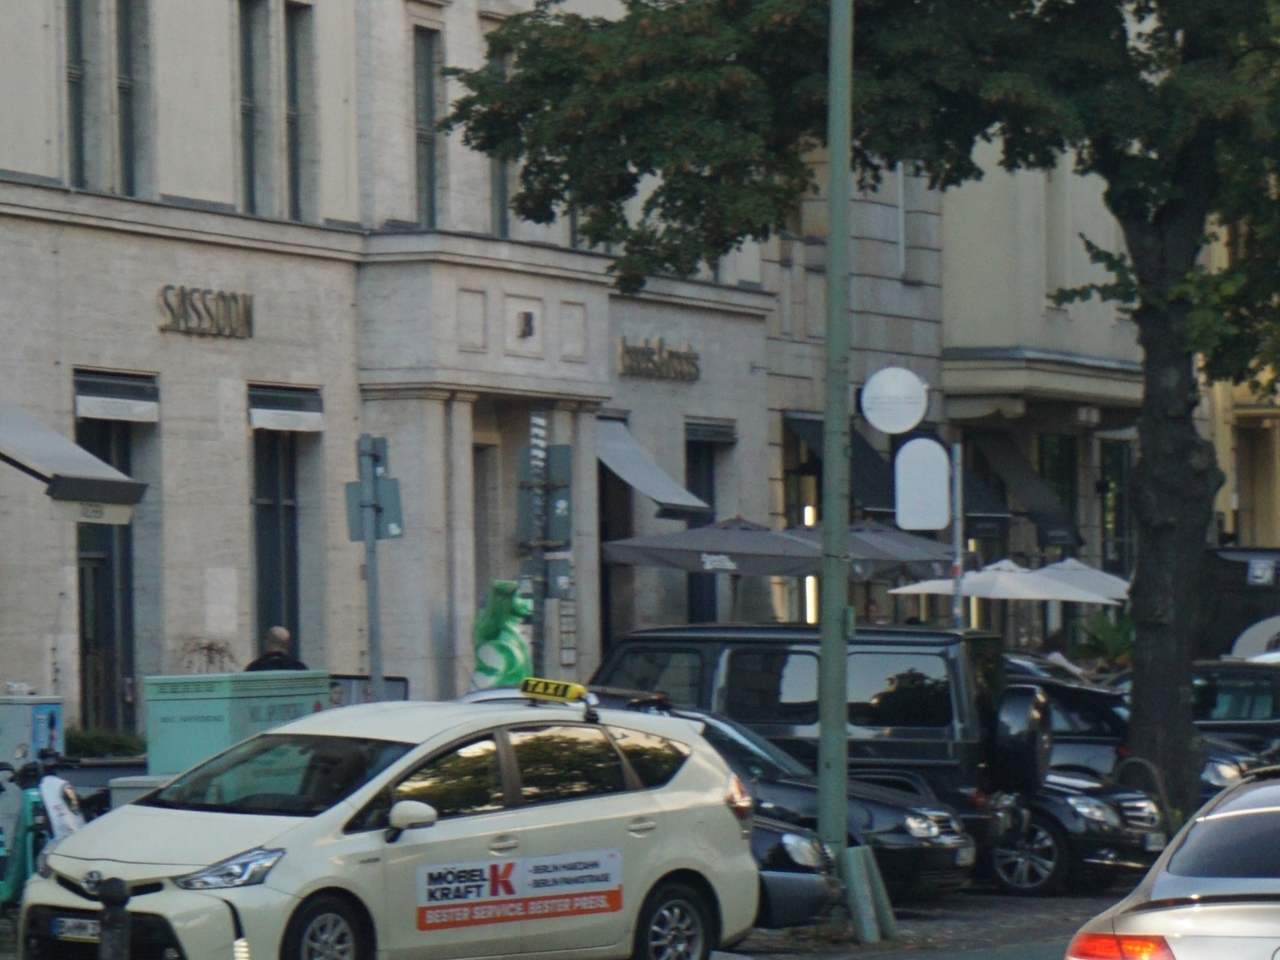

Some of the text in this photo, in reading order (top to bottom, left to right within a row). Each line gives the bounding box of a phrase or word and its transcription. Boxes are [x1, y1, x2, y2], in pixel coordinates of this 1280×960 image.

[159, 284, 254, 339] SASSOON
[526, 680, 566, 696] TAXI
[427, 867, 488, 886] MÖBEL
[488, 863, 516, 897] K
[427, 884, 484, 902] KRAFT
[425, 907, 470, 924] BESTER
[528, 898, 571, 914] BESTER
